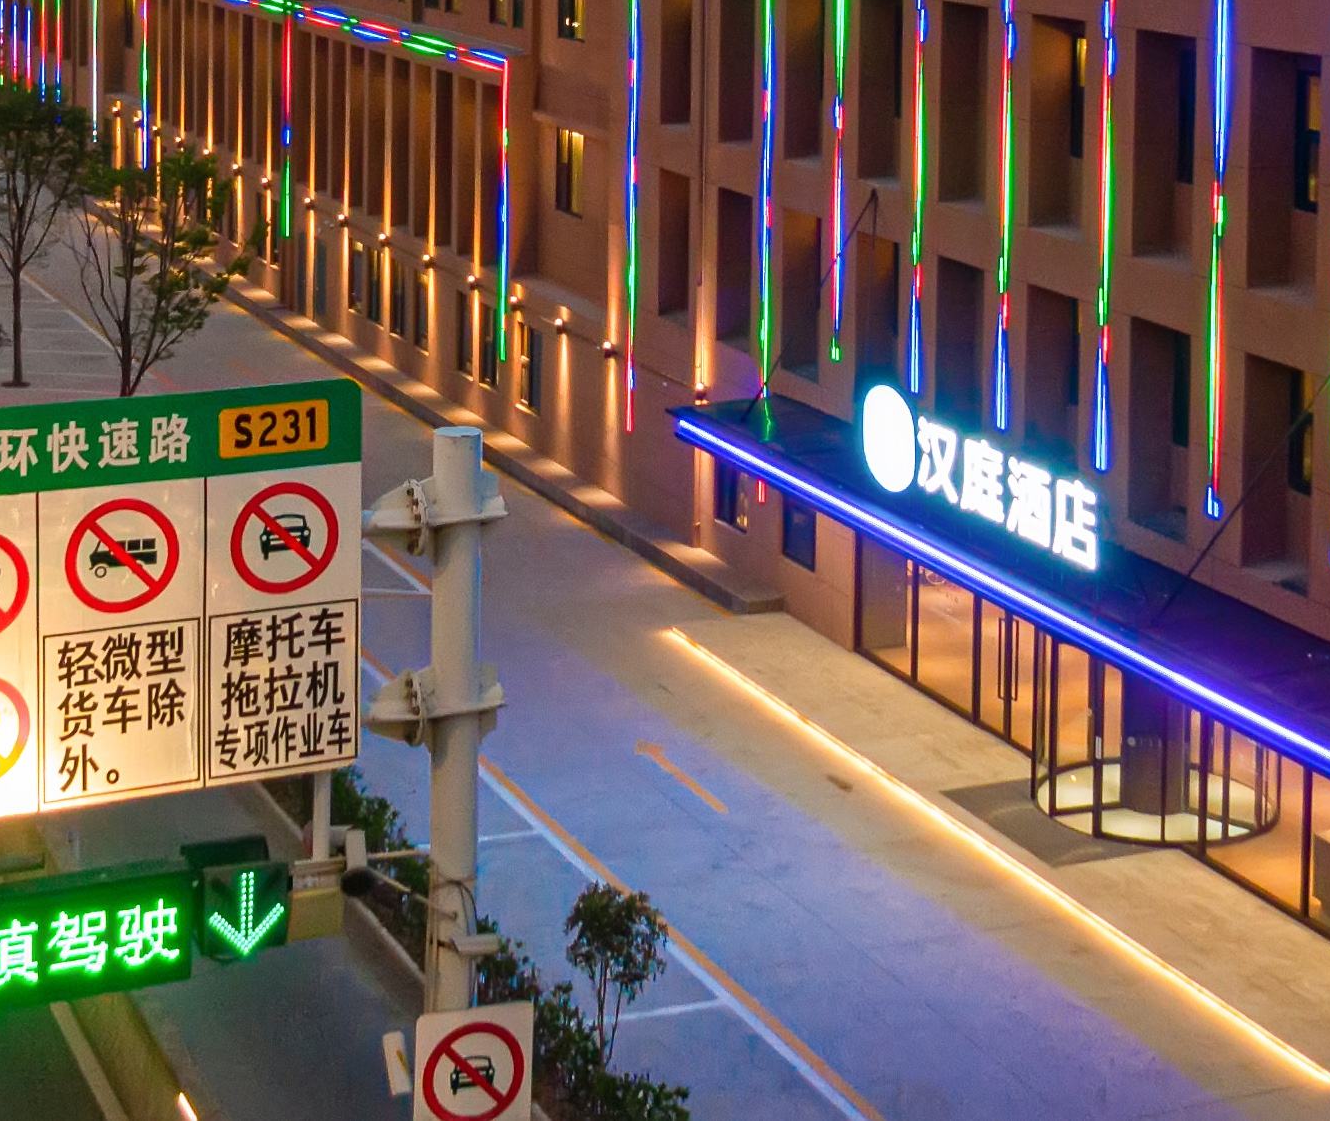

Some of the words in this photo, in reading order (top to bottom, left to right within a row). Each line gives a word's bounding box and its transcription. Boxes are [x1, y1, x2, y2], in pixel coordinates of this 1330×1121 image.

[233, 407, 318, 449] S231
[917, 415, 1098, 571] 汉庭酒店
[57, 625, 185, 689] 轻微型
[223, 608, 345, 669] 摩托车
[58, 678, 186, 742] 货车除
[221, 660, 344, 721] 拖拉机
[58, 743, 120, 792] 外。
[215, 708, 351, 770] 专项作业车
